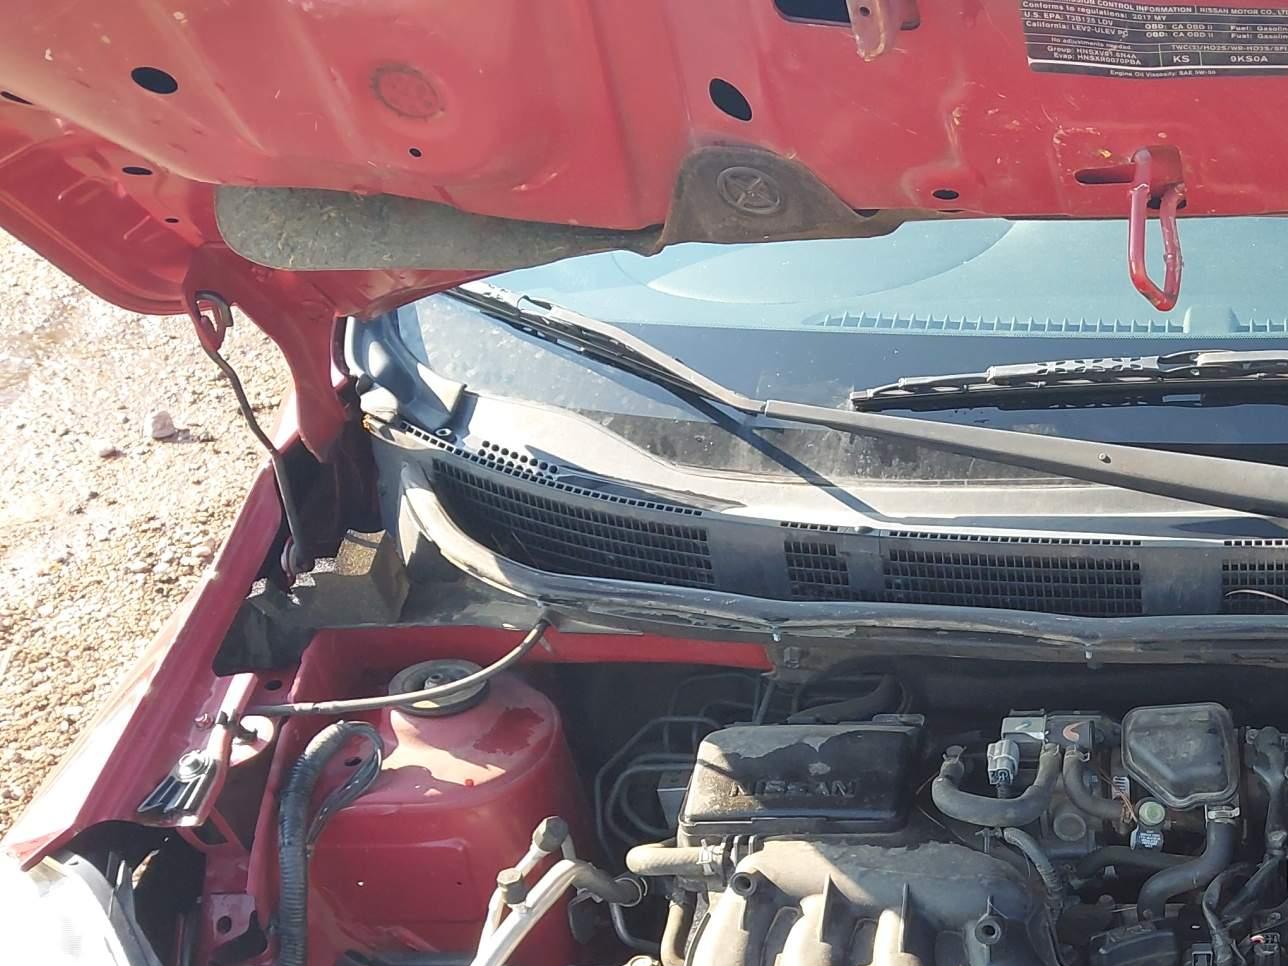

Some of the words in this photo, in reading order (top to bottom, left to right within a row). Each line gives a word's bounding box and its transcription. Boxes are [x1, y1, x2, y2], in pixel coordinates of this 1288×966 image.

[1022, 2, 1064, 11] Conforms
[1078, 7, 1128, 18] regulations:
[1098, 0, 1134, 10] CONTROL
[1136, 5, 1192, 13] INFORMATION
[1025, 21, 1070, 30] California:
[1053, 52, 1075, 60] Evap:
[1172, 55, 1190, 63] KS
